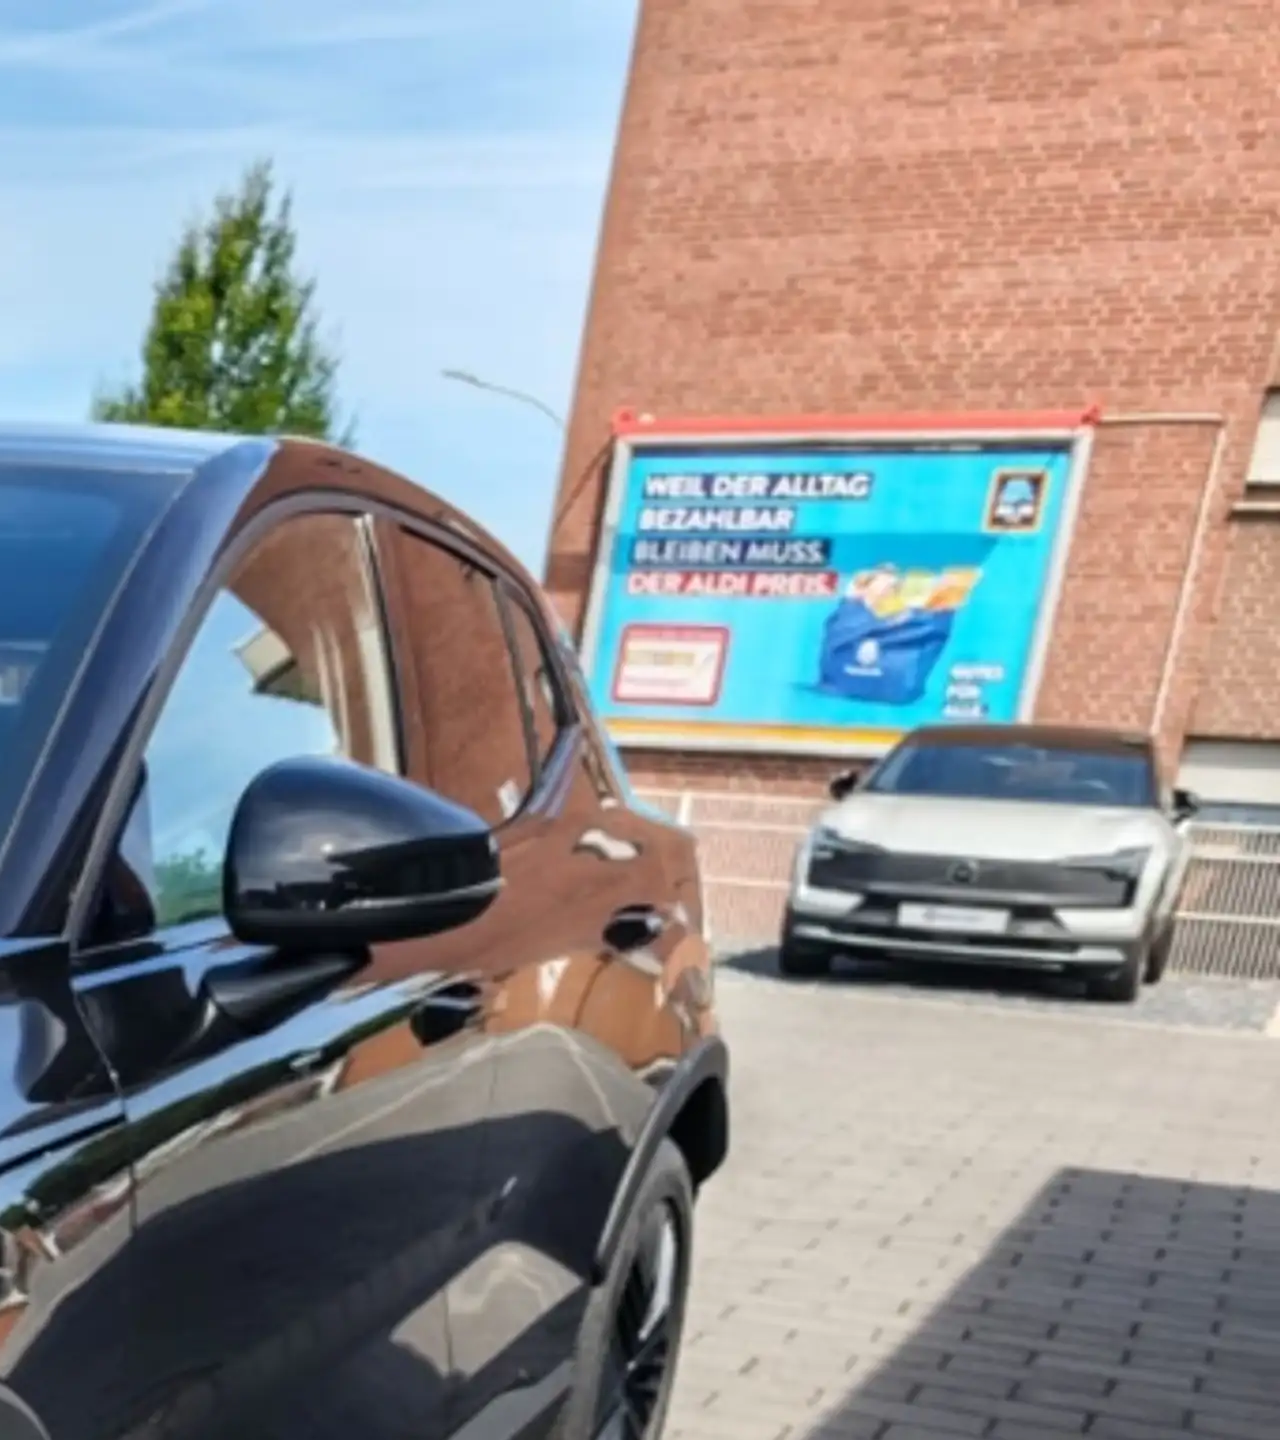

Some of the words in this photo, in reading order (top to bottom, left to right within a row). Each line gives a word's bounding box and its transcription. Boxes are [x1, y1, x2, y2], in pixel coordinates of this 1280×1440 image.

[645, 474, 704, 497] WEIL
[712, 474, 769, 498] DER
[771, 473, 870, 498] ALLTAG
[639, 507, 794, 531] BEZAHLBAR
[634, 539, 740, 563] BLEIBEN
[628, 571, 681, 595] DER
[683, 573, 747, 595] ALDI
